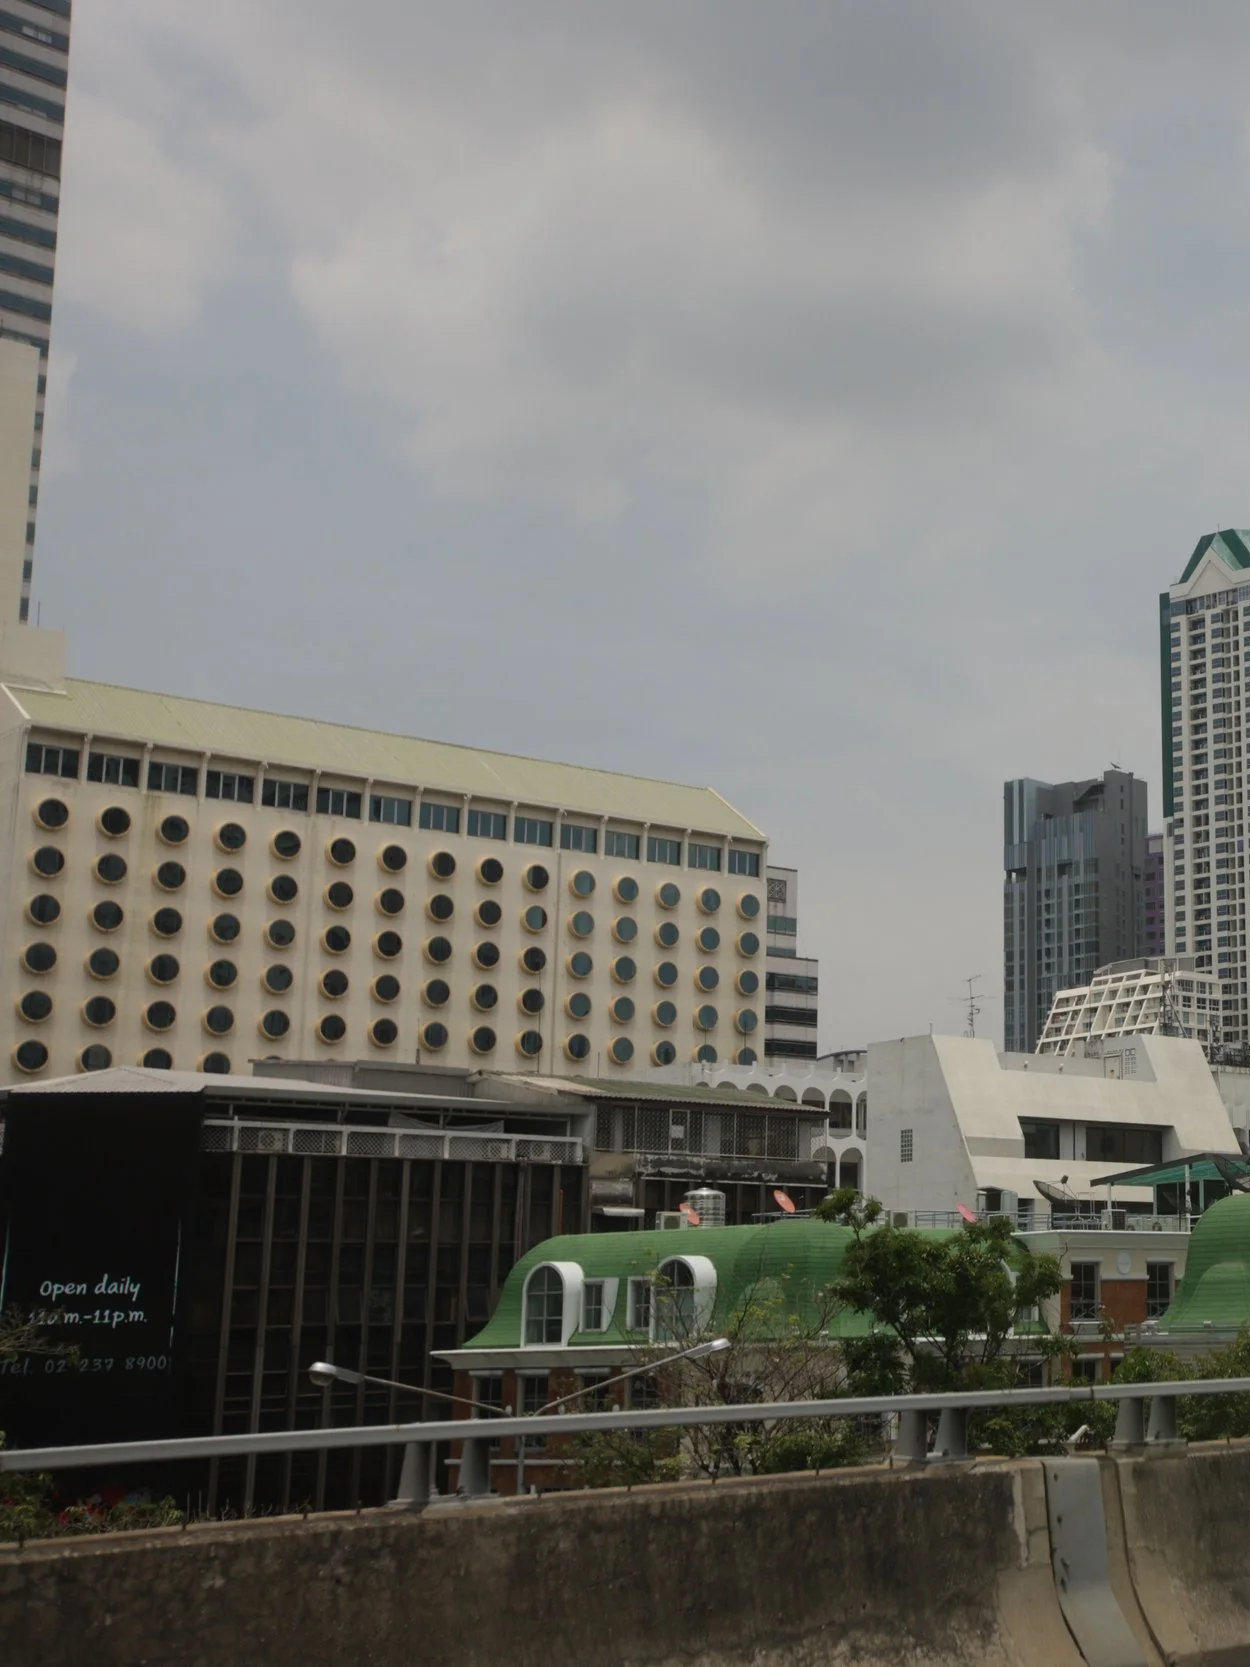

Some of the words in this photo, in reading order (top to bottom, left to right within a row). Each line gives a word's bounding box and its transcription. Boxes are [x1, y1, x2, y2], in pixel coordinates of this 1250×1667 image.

[39, 1280, 87, 1302] Open
[94, 1273, 141, 1302] daily
[44, 1358, 68, 1374] 02
[79, 1357, 115, 1373] 237
[124, 1354, 167, 1371] 8900
